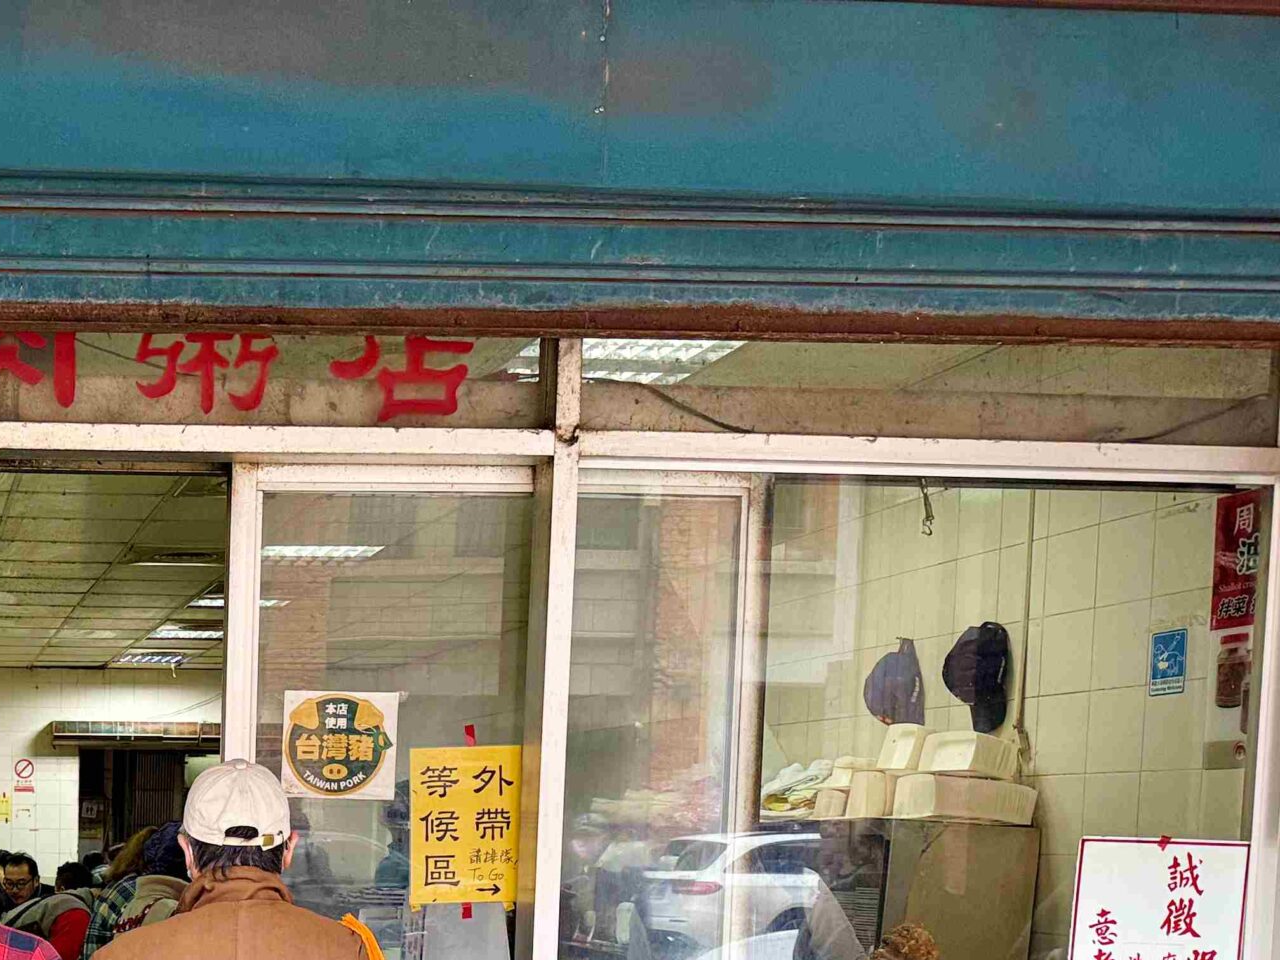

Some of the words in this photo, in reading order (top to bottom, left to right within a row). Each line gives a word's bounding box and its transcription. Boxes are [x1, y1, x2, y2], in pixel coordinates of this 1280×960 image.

[325, 703, 348, 715] 本店
[325, 717, 347, 729] 使用
[296, 734, 374, 761] 台灣豬
[303, 770, 338, 790] TAIWAN
[340, 772, 367, 790] PORK
[472, 764, 515, 841] 外帶
[420, 765, 461, 887] 等候區
[468, 867, 484, 882] To
[488, 867, 505, 881] Go
